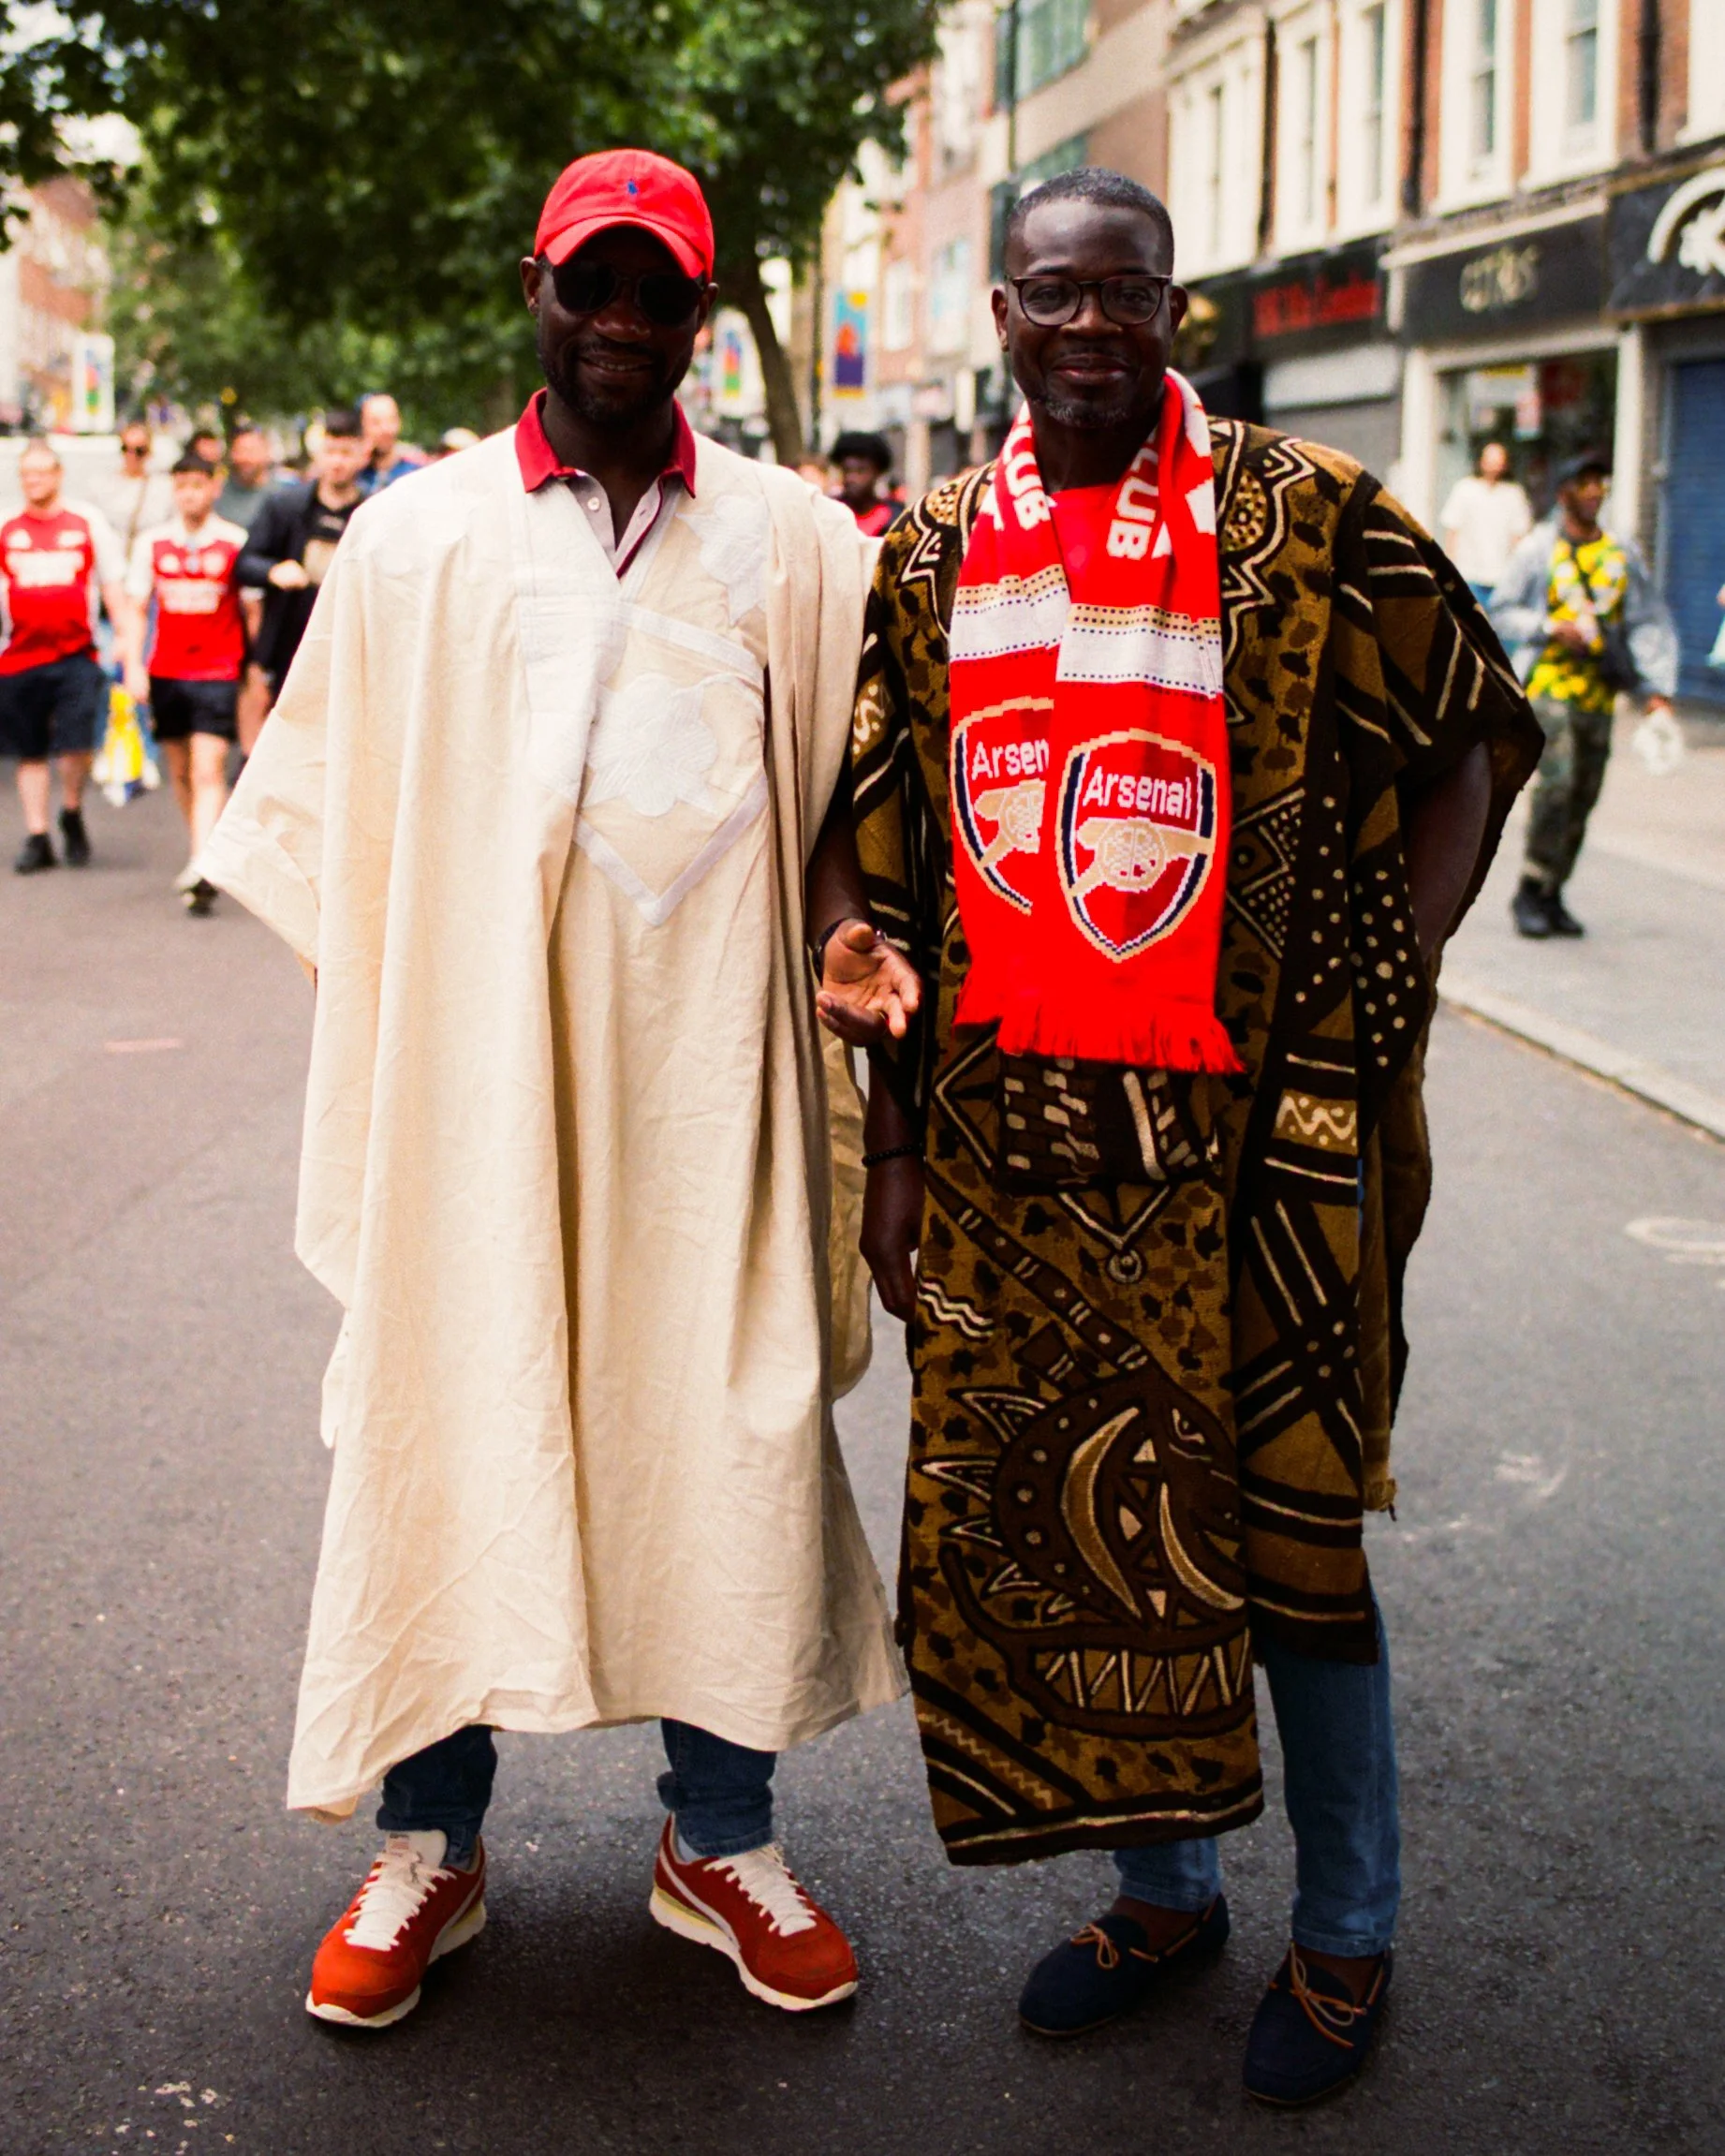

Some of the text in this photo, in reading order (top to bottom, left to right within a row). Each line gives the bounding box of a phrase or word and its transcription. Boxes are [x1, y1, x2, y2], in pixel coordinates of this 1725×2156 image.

[1003, 401, 1051, 531] LUB
[1106, 426, 1158, 560] LUB
[1082, 765, 1191, 820] Arsenal
